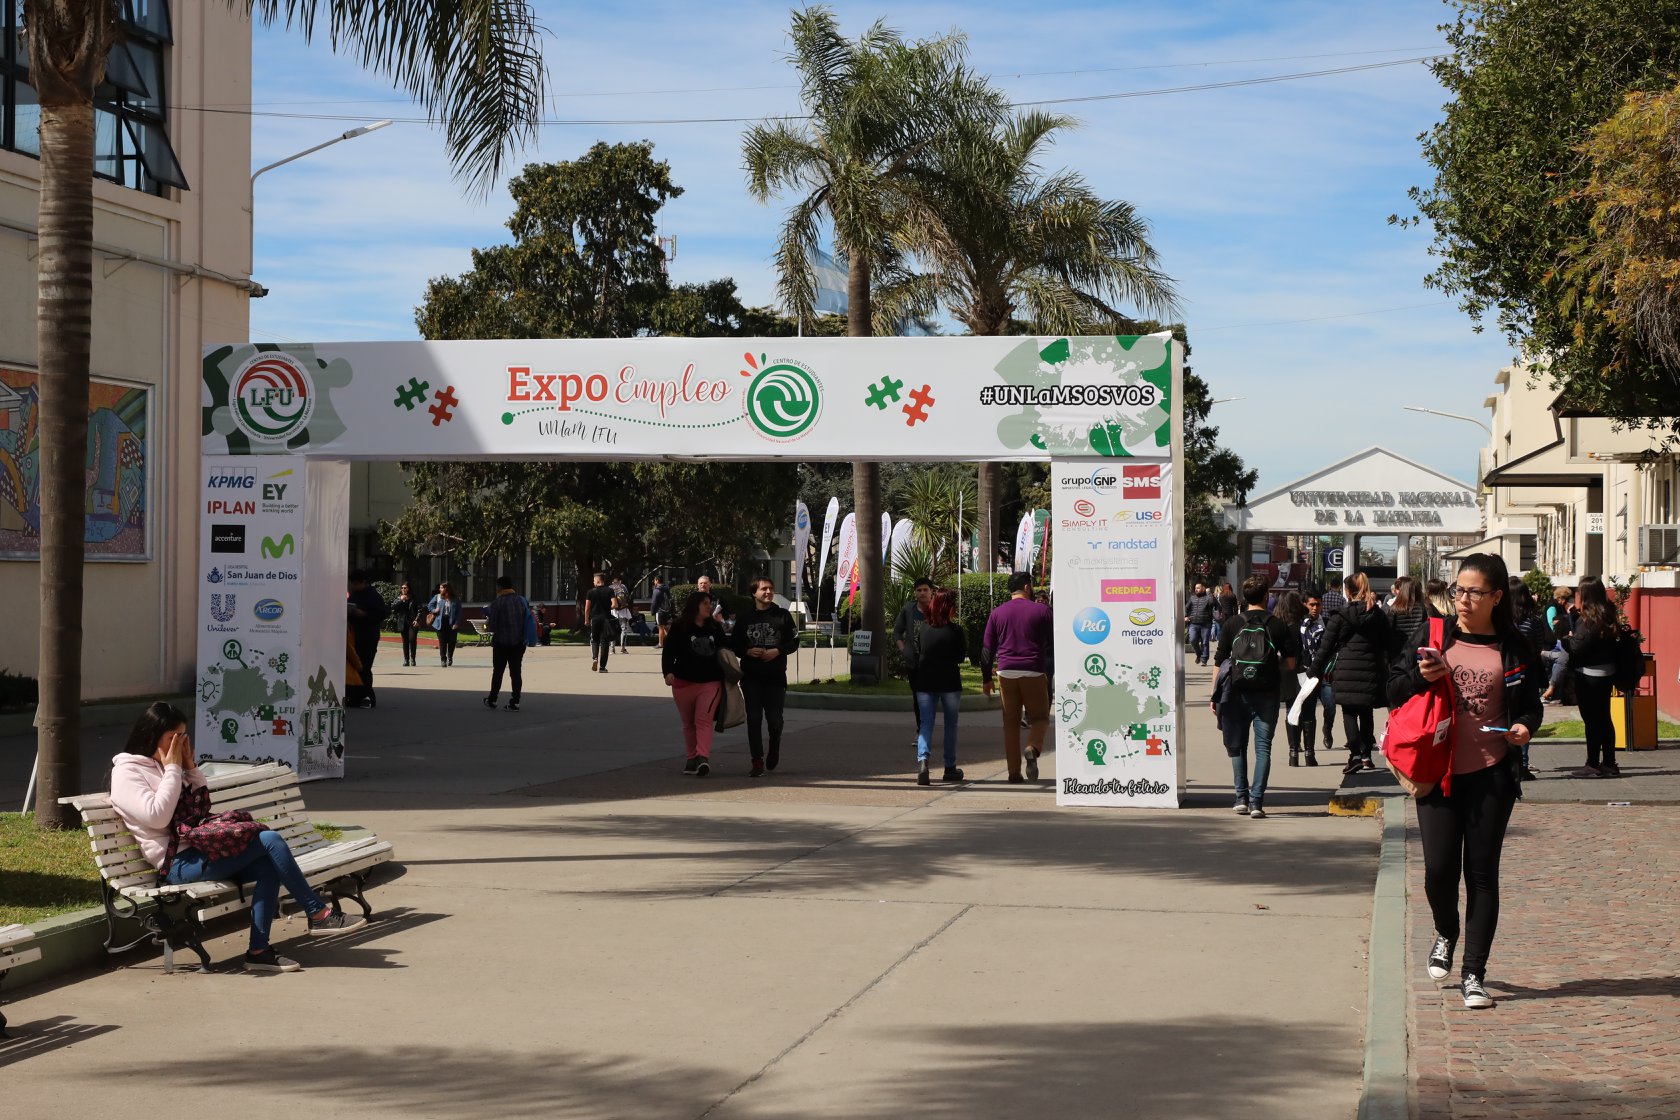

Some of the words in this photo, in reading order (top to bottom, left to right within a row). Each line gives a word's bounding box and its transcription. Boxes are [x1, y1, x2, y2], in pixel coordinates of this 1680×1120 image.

[794, 359, 802, 367] DE
[801, 363, 825, 392] ESTUDIANTES
[507, 366, 609, 411] Expo
[615, 363, 732, 419] Empleo
[980, 385, 1155, 405] #UNLaMSOSVOS
[208, 475, 255, 488] KPMG
[1093, 476, 1117, 486] GNP
[1123, 476, 1161, 488] SMS
[262, 483, 287, 500] EY
[1290, 491, 1394, 507] UNIVERSIDAD
[1398, 491, 1475, 507] NACIONAL
[207, 500, 256, 514] IPLAN
[1135, 510, 1162, 521] use
[1314, 509, 1338, 525] DE
[1344, 510, 1366, 526] LA
[1373, 510, 1444, 527] MATANZA
[215, 534, 242, 542] accenture
[1108, 538, 1157, 549] randstad
[227, 571, 243, 579] San
[244, 571, 264, 579] Juan
[265, 571, 276, 579] de
[278, 572, 297, 580] Dios
[1105, 586, 1152, 595] CREDIPAZ
[255, 605, 283, 614] ARCOR
[207, 624, 239, 632] Unilever
[1081, 619, 1107, 632] P&G
[1122, 629, 1164, 637] mercado
[1132, 636, 1153, 645] libre
[279, 706, 296, 714] LFU
[1153, 725, 1171, 733] LFU
[1063, 778, 1110, 794] Ideando
[1111, 778, 1127, 794] tu
[1126, 778, 1169, 797] futuro
